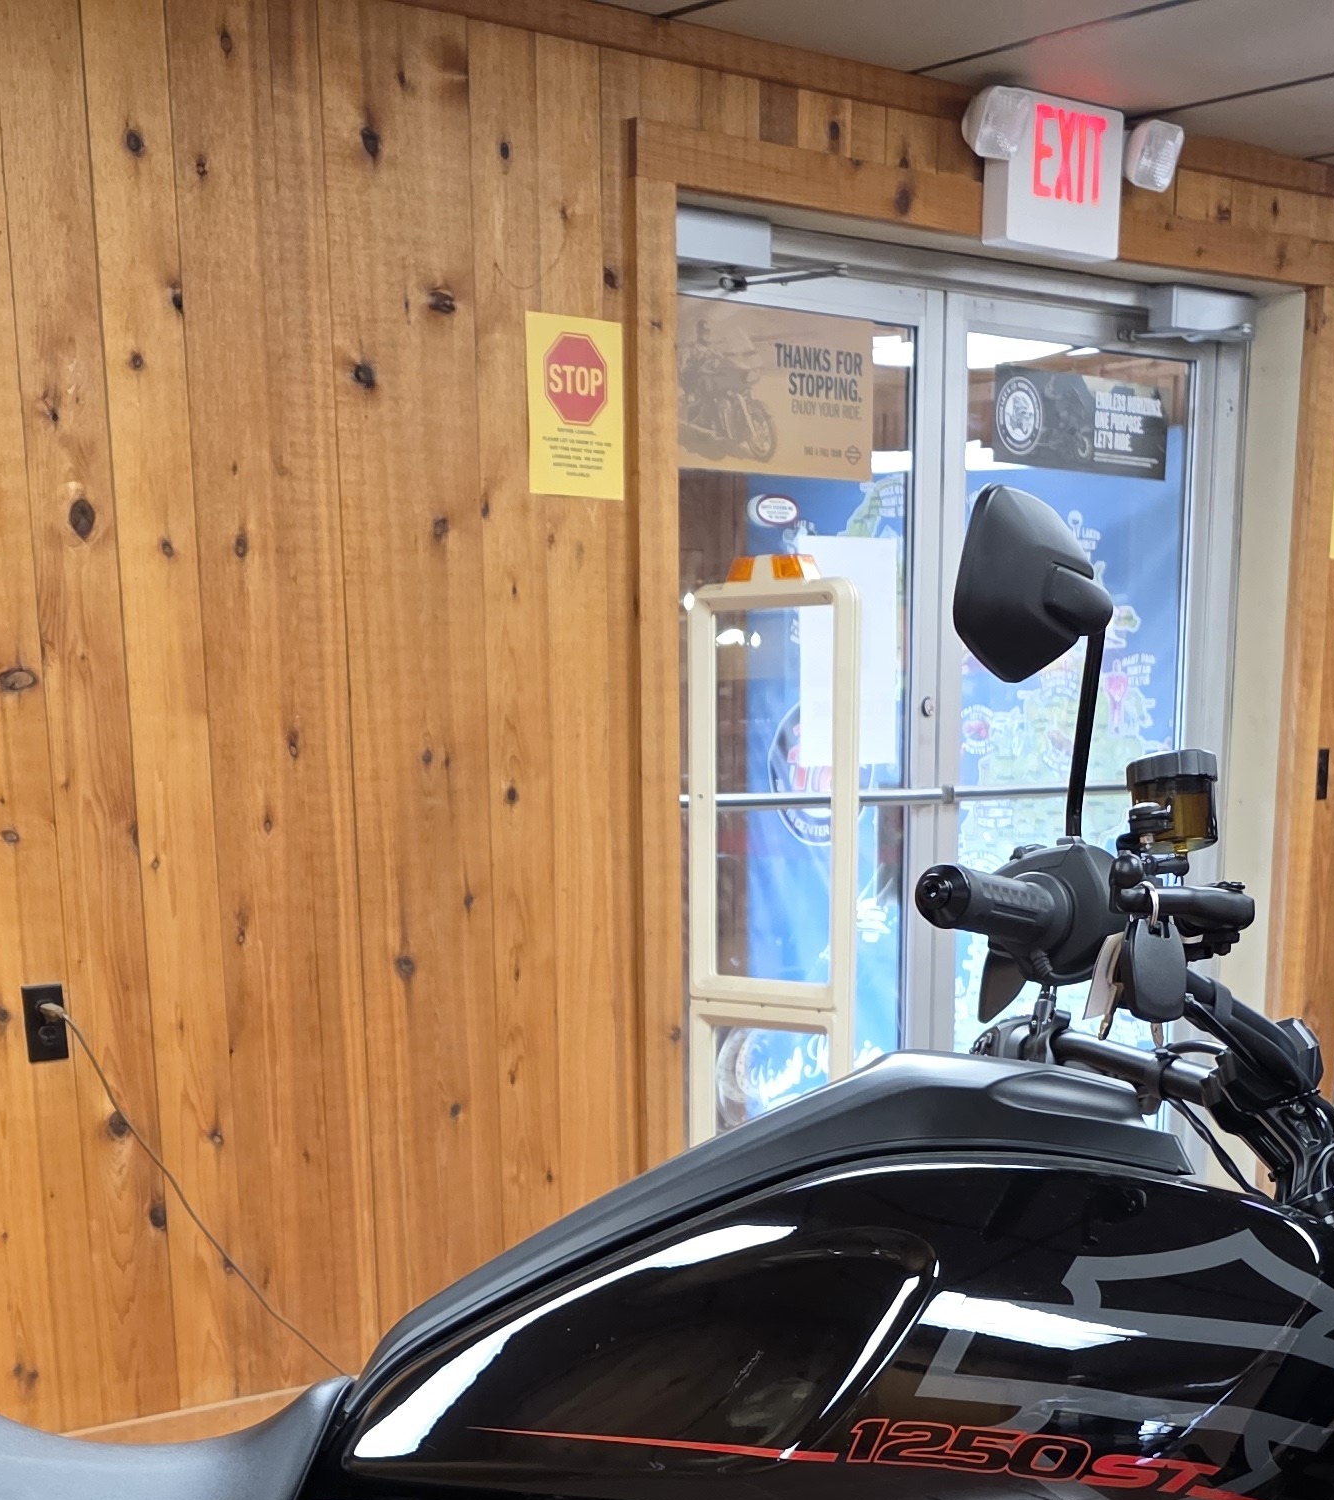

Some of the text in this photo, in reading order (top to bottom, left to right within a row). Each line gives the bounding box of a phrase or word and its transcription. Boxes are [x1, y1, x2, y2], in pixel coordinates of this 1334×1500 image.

[1033, 104, 1107, 206] EXIT
[775, 343, 863, 376] THANKS FOR
[549, 364, 603, 397] STOP
[788, 372, 862, 403] STOPPING.
[791, 399, 817, 415] ENJOY
[818, 401, 840, 418] YOUR
